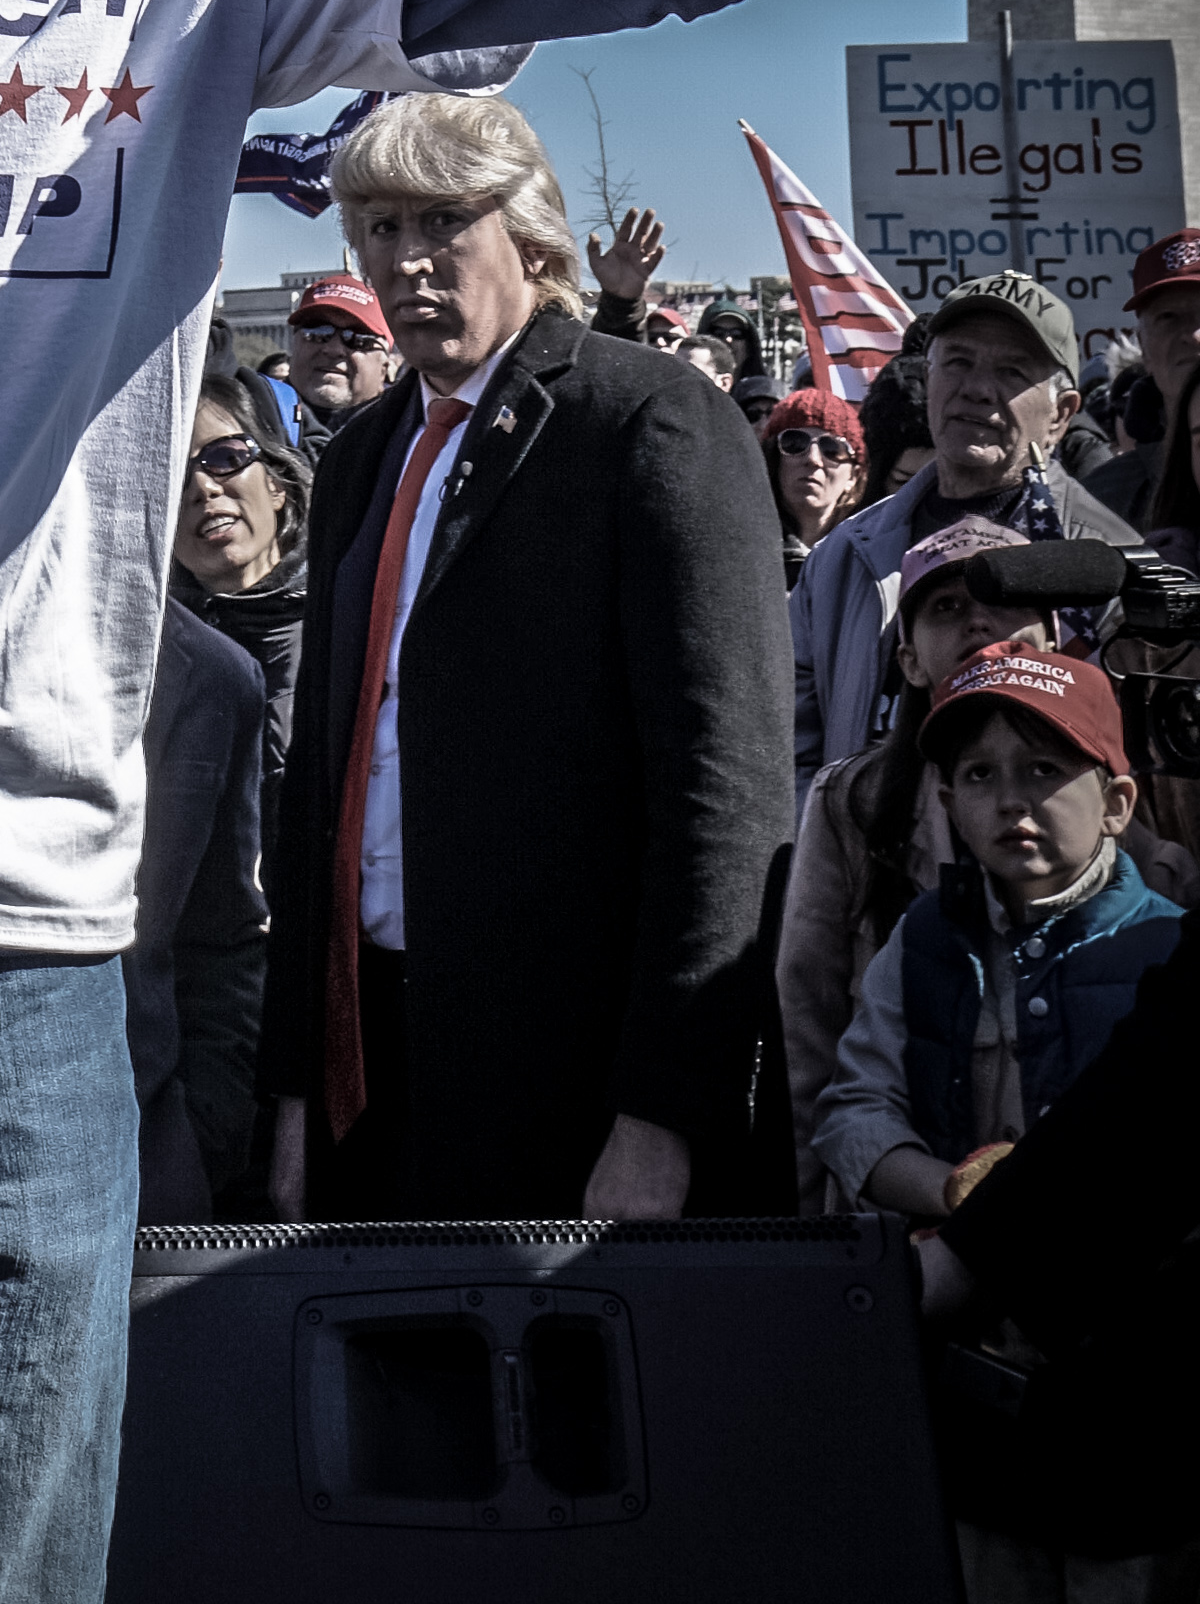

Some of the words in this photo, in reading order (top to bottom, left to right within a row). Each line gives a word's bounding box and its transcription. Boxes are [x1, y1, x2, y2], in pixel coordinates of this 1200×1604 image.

[877, 53, 1157, 135] Exporting
[889, 117, 1144, 192] Illegals
[896, 258, 980, 301] Job
[993, 656, 1076, 685] AMERICA
[1005, 672, 1066, 697] AGAIN
